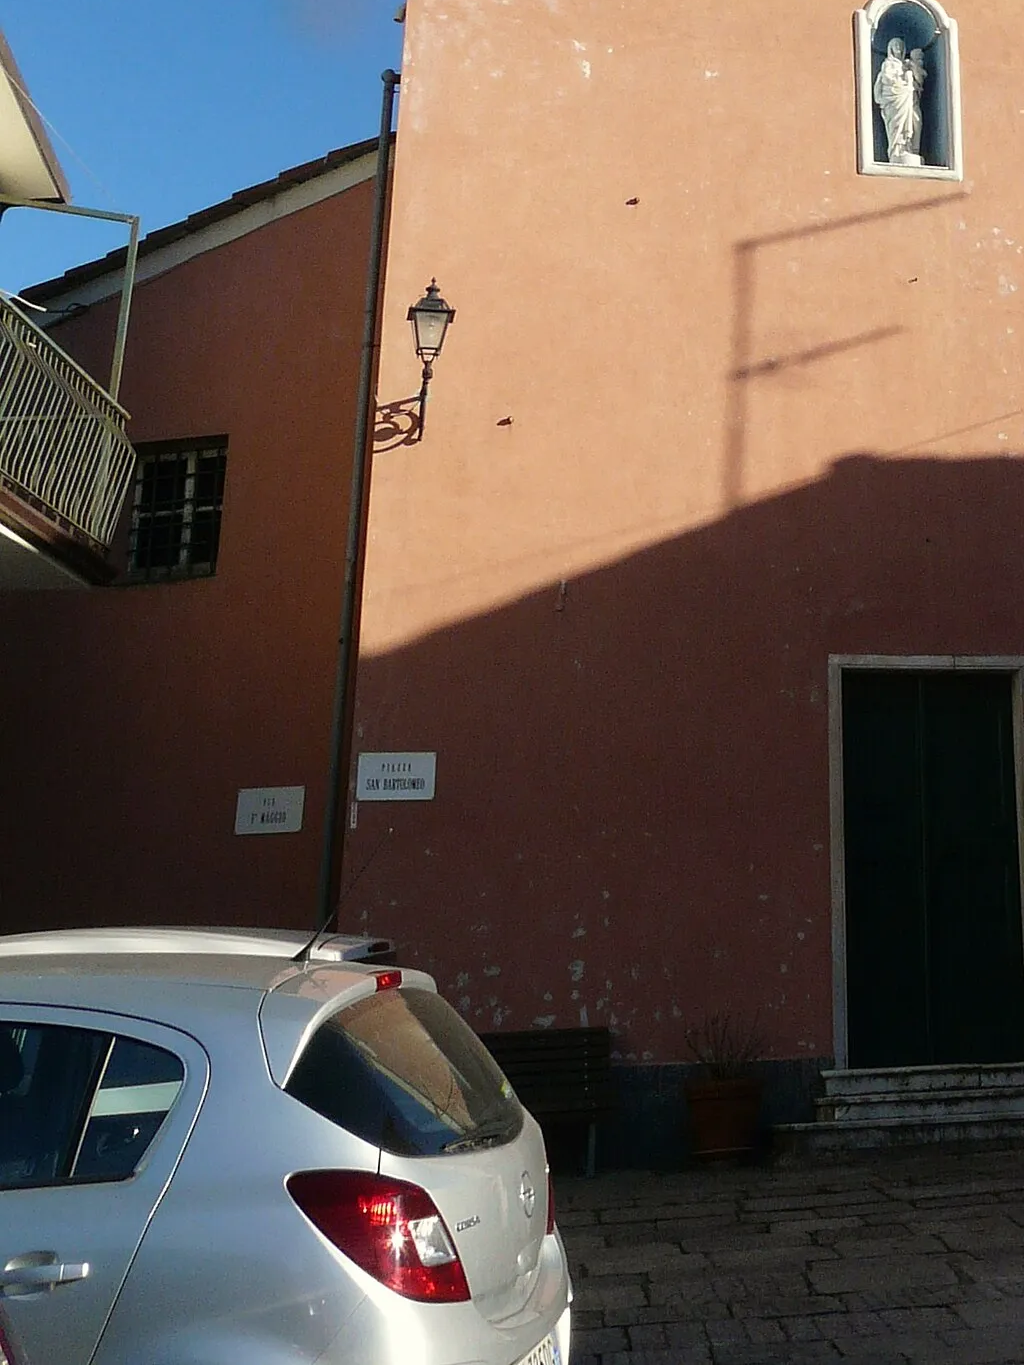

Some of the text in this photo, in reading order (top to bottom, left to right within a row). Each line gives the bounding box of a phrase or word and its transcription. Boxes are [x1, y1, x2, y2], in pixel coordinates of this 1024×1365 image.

[381, 762, 412, 772] PIAZZA
[365, 777, 426, 791] SAN BARTOLOMEO
